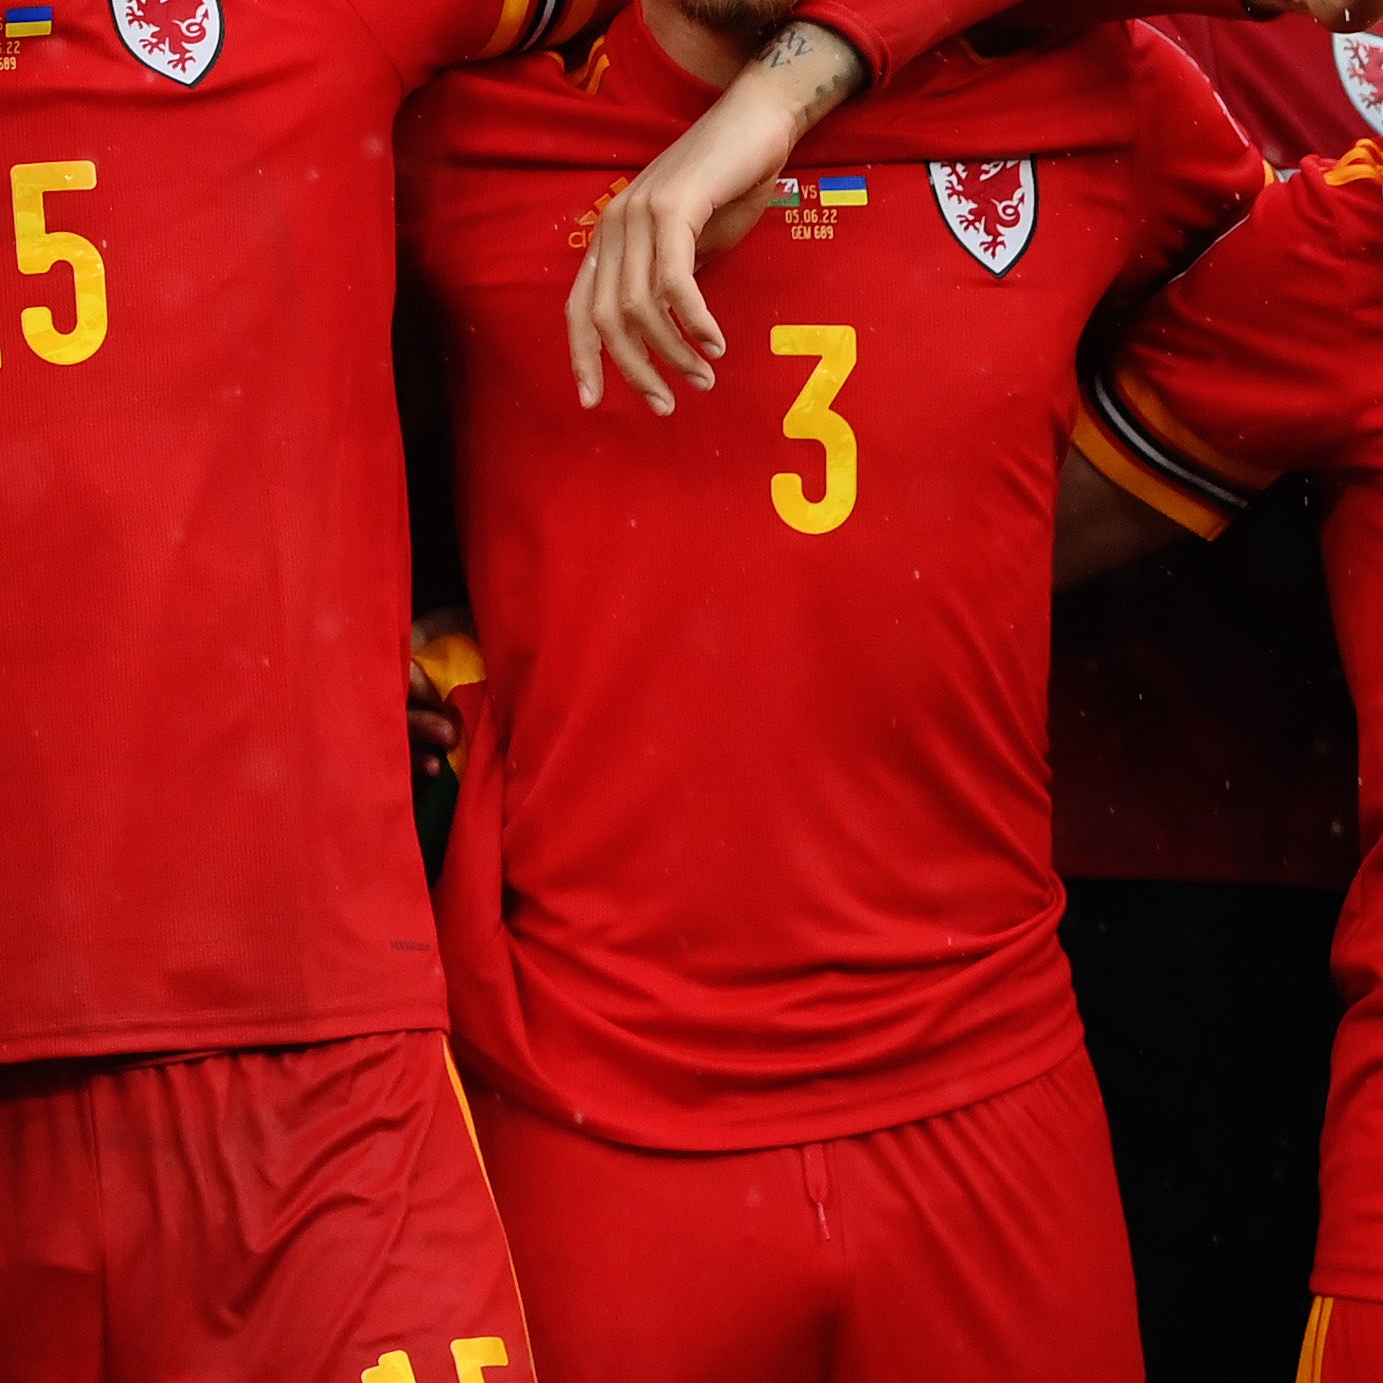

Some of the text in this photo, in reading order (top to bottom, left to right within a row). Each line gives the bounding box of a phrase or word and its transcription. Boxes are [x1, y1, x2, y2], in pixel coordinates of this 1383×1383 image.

[801, 185, 818, 200] VS
[785, 209, 838, 224] 05.06.22
[770, 324, 858, 535] 3
